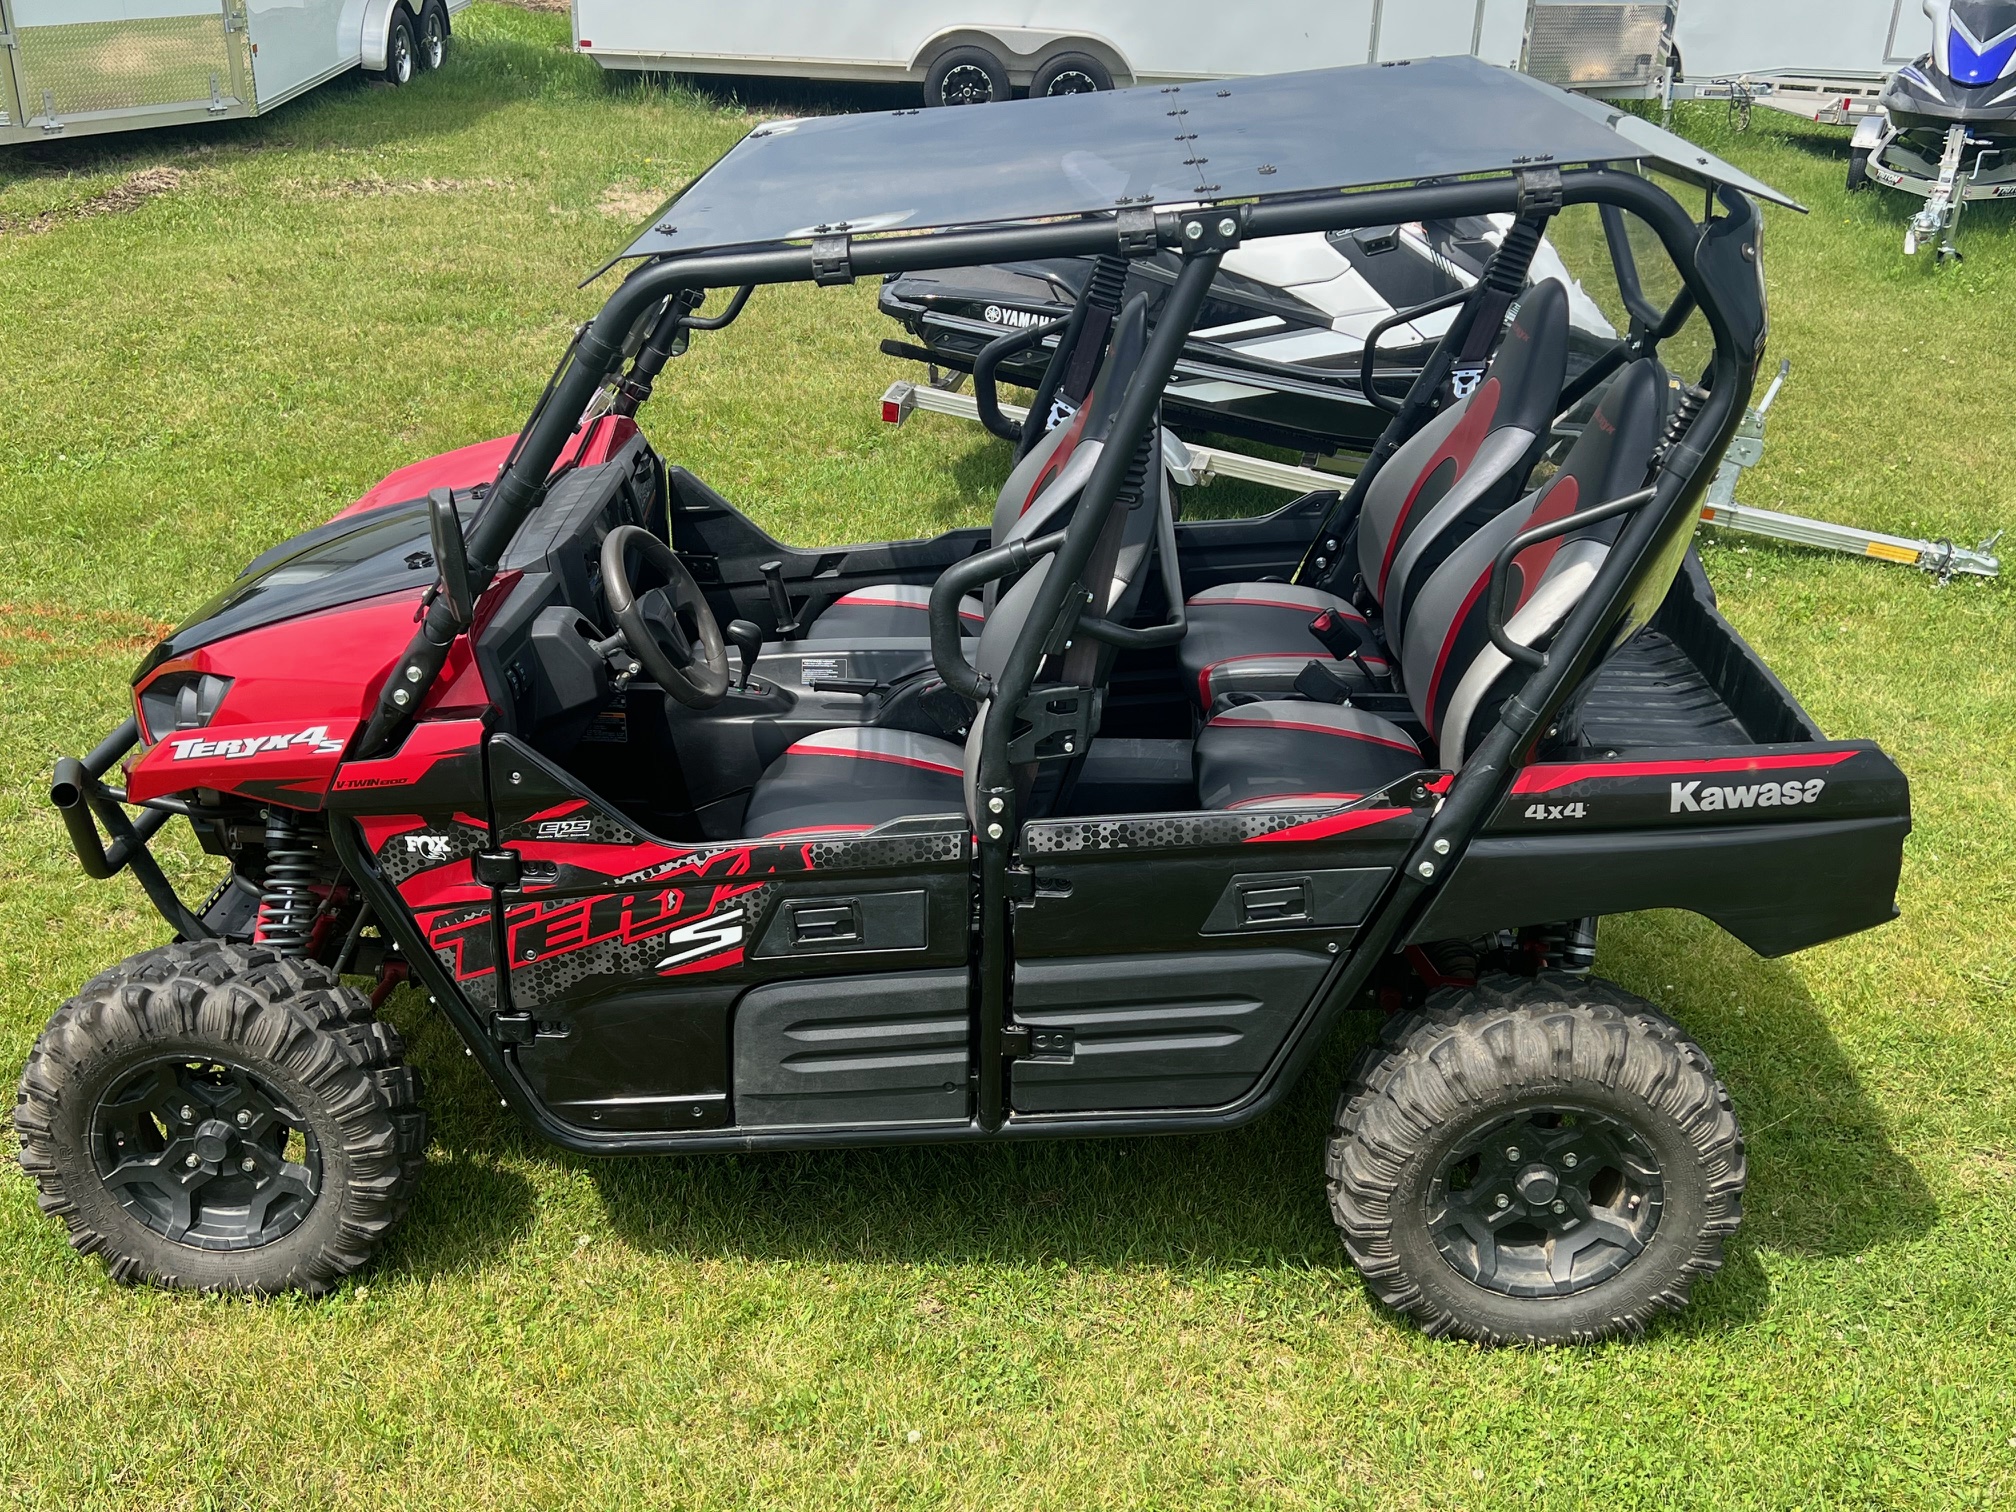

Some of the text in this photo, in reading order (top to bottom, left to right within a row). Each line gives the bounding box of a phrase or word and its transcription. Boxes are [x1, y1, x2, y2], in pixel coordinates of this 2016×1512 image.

[336, 778, 380, 790] V-TWIN
[1524, 802, 1587, 820] 4x4
[538, 820, 591, 838] EPS
[404, 834, 451, 861] FOX
[1570, 1244, 1686, 1327] CARLSTAR
